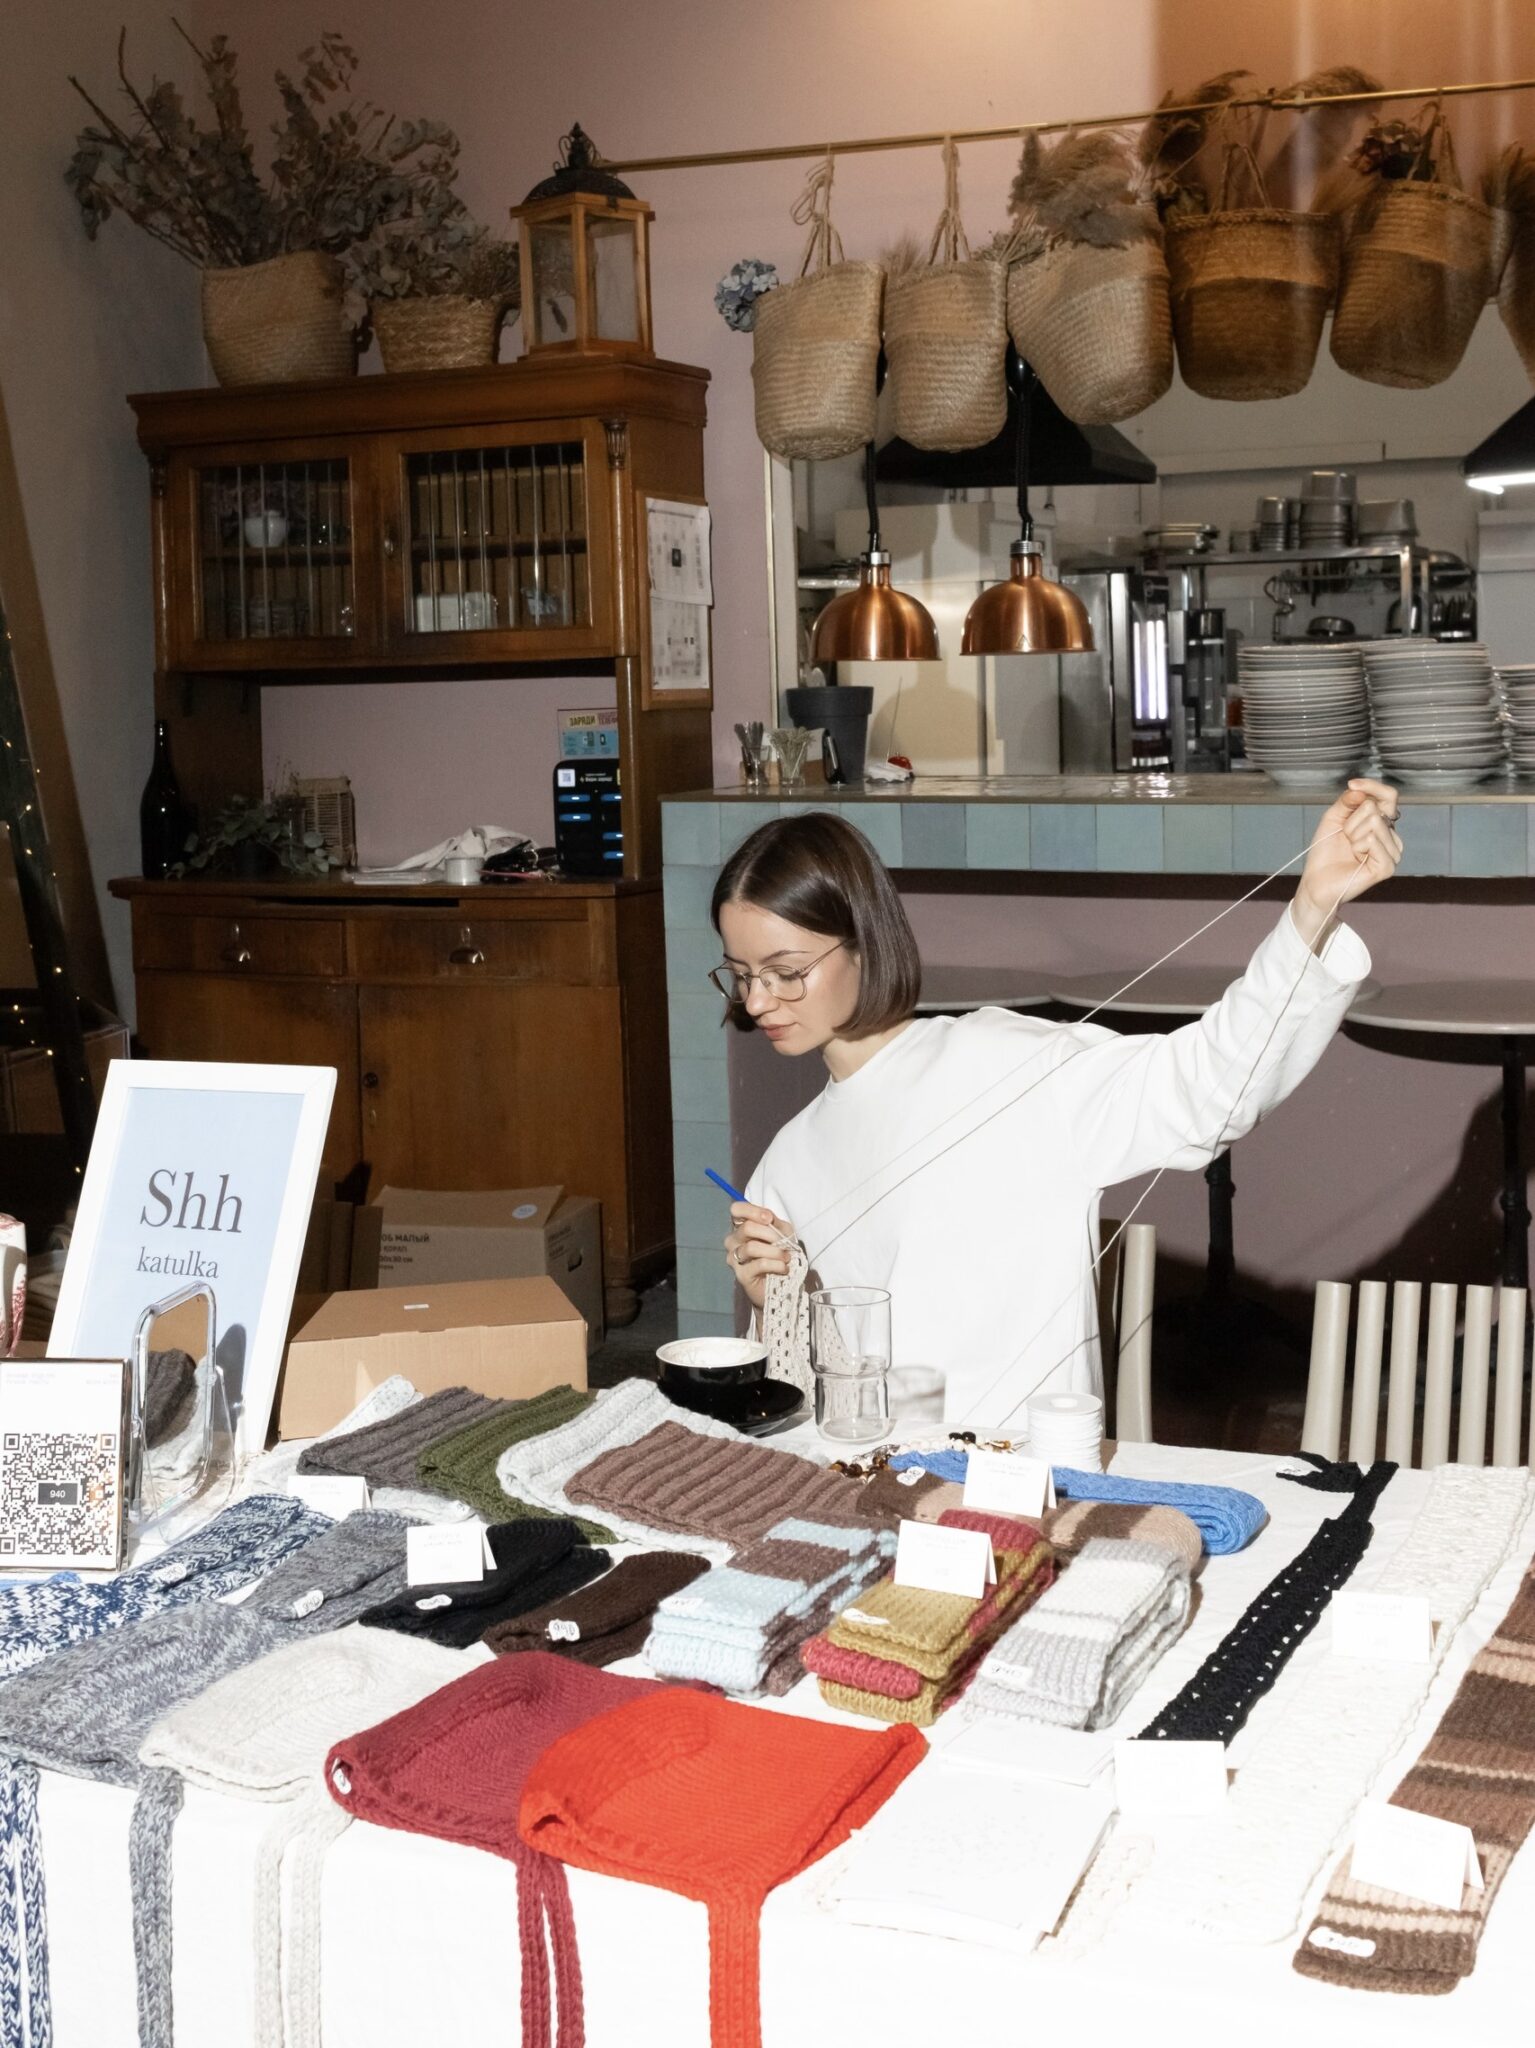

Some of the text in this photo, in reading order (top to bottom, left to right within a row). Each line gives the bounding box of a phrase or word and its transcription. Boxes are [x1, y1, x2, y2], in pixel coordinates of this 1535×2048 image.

[140, 1169, 242, 1233] Shh
[395, 1233, 430, 1242] МАЛЫЙ
[136, 1245, 219, 1279] katulka
[50, 1490, 66, 1499] 940
